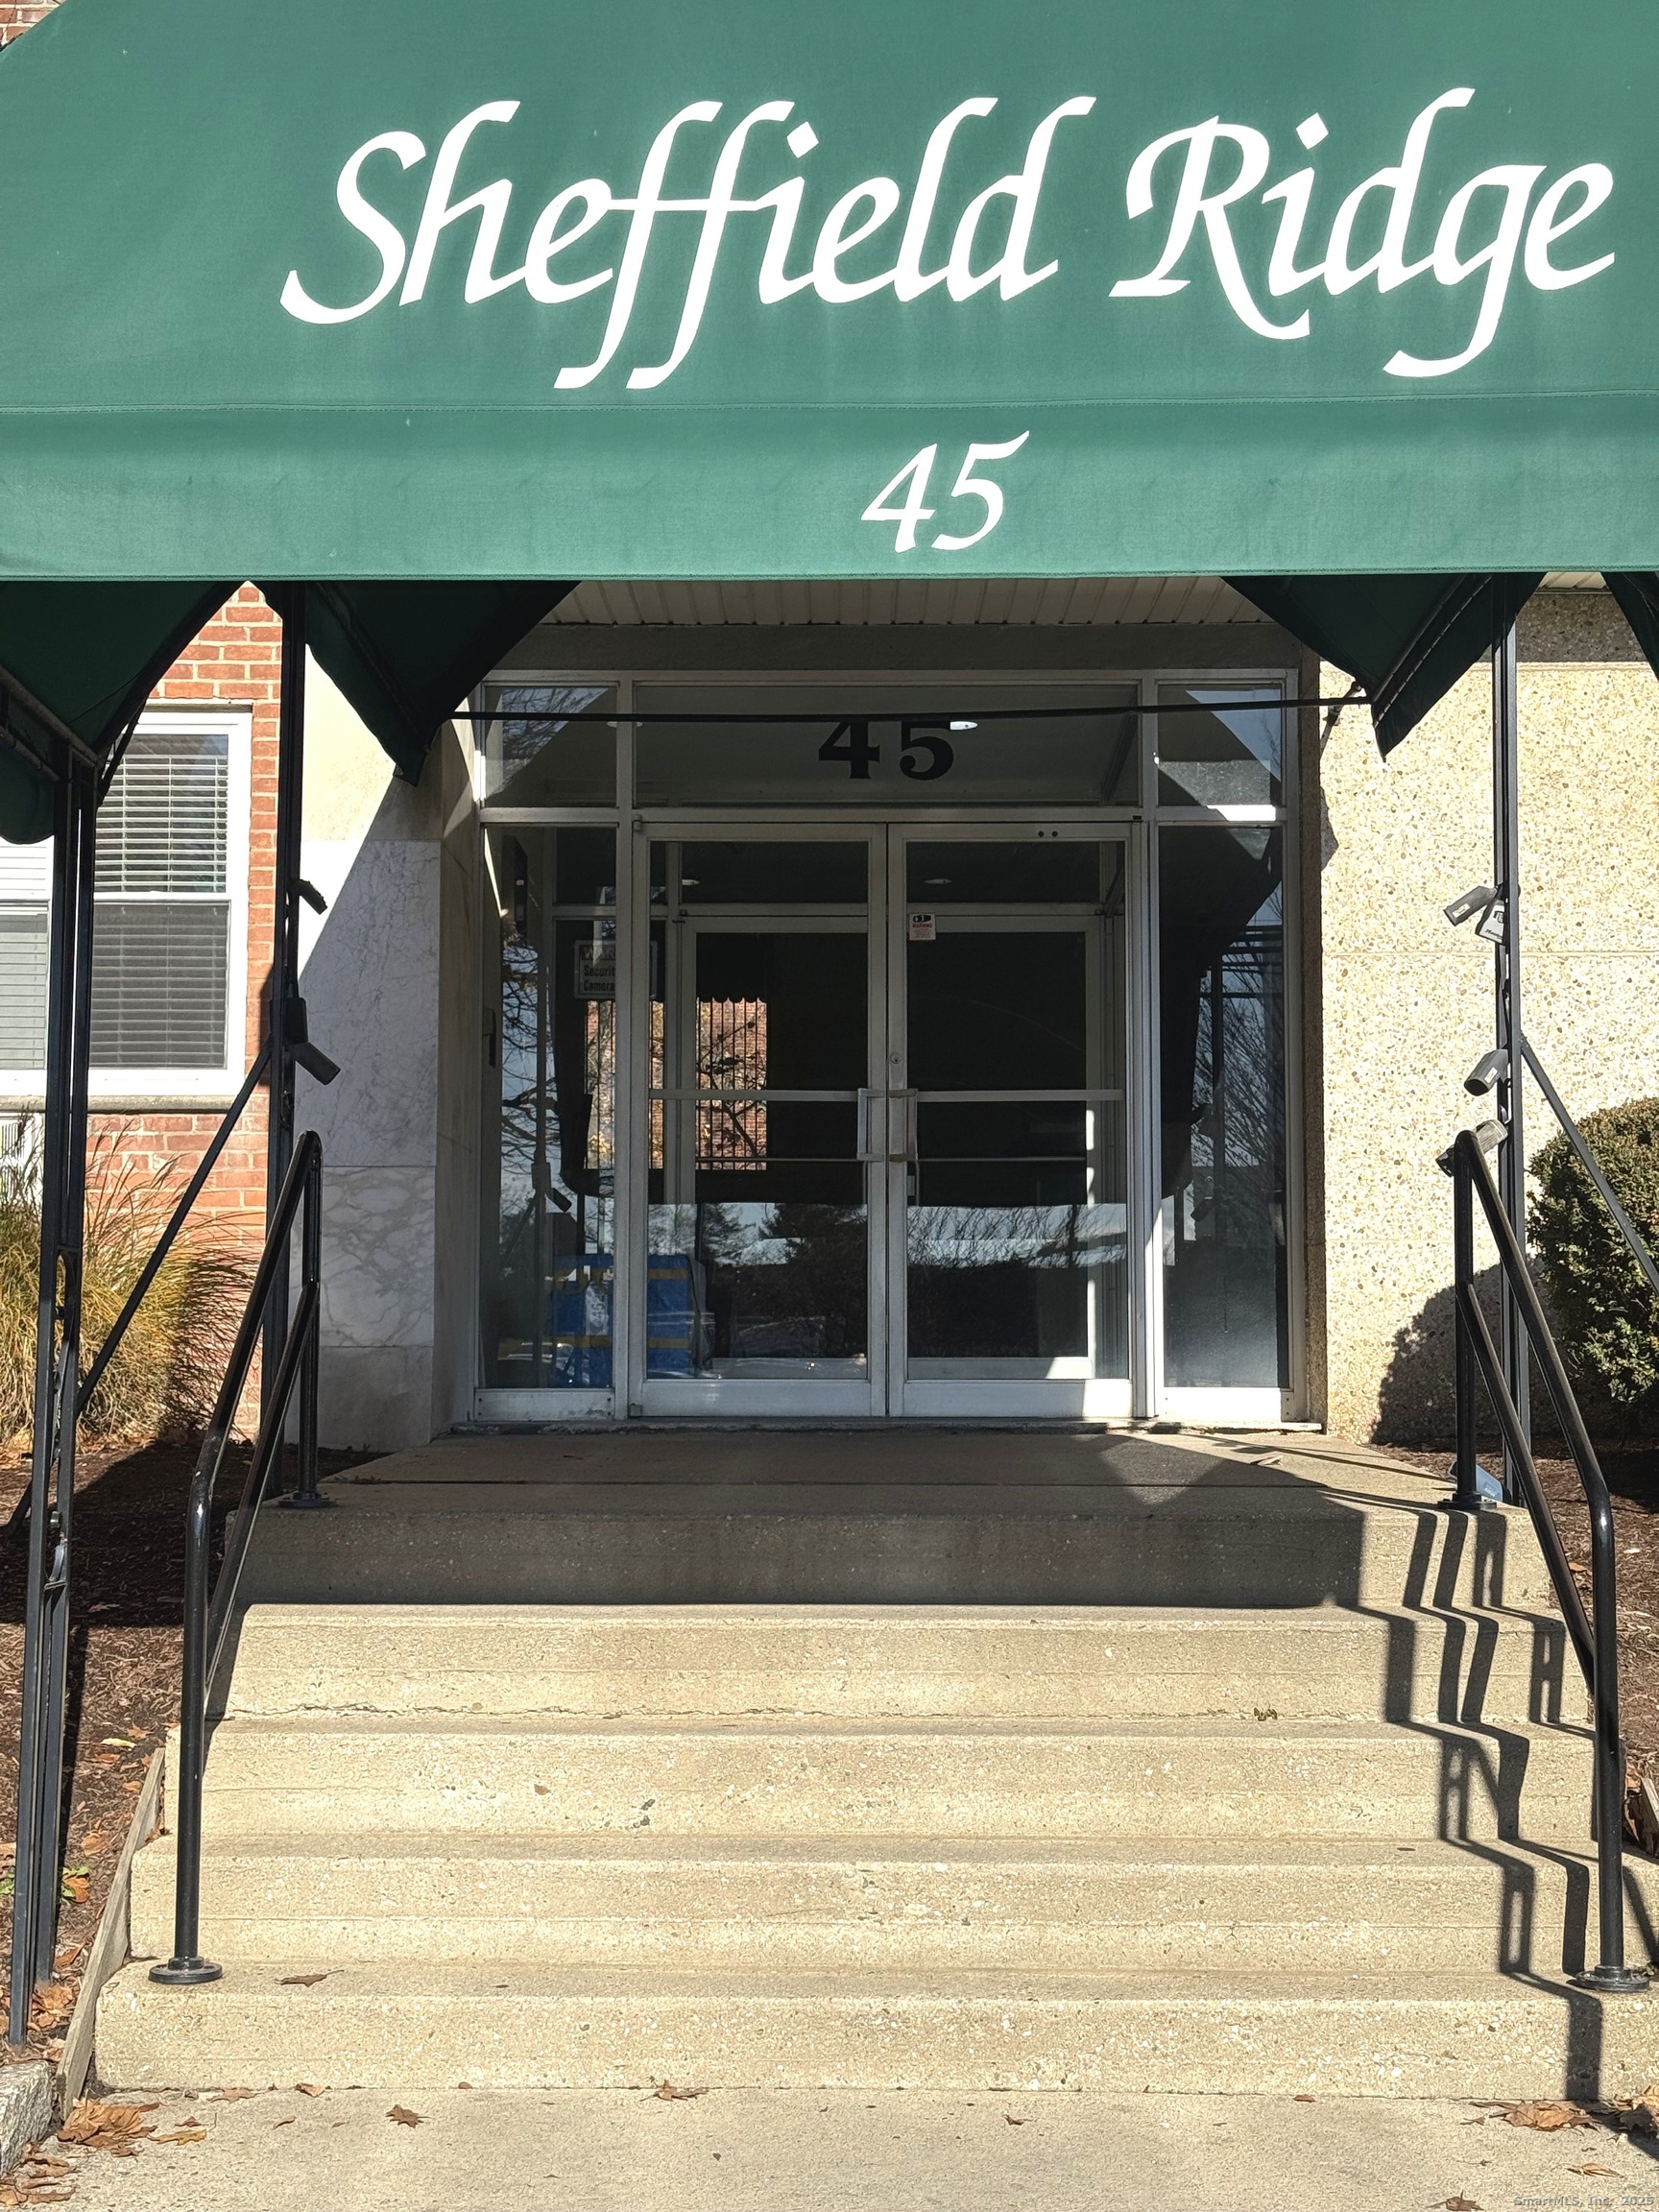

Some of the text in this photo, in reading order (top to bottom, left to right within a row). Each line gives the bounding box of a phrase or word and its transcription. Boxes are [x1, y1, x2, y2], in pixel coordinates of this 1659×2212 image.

[280, 87, 1616, 391] Sheffield Ridge
[861, 431, 1031, 555] 45
[819, 720, 954, 781] 45
[584, 964, 615, 977] Securit
